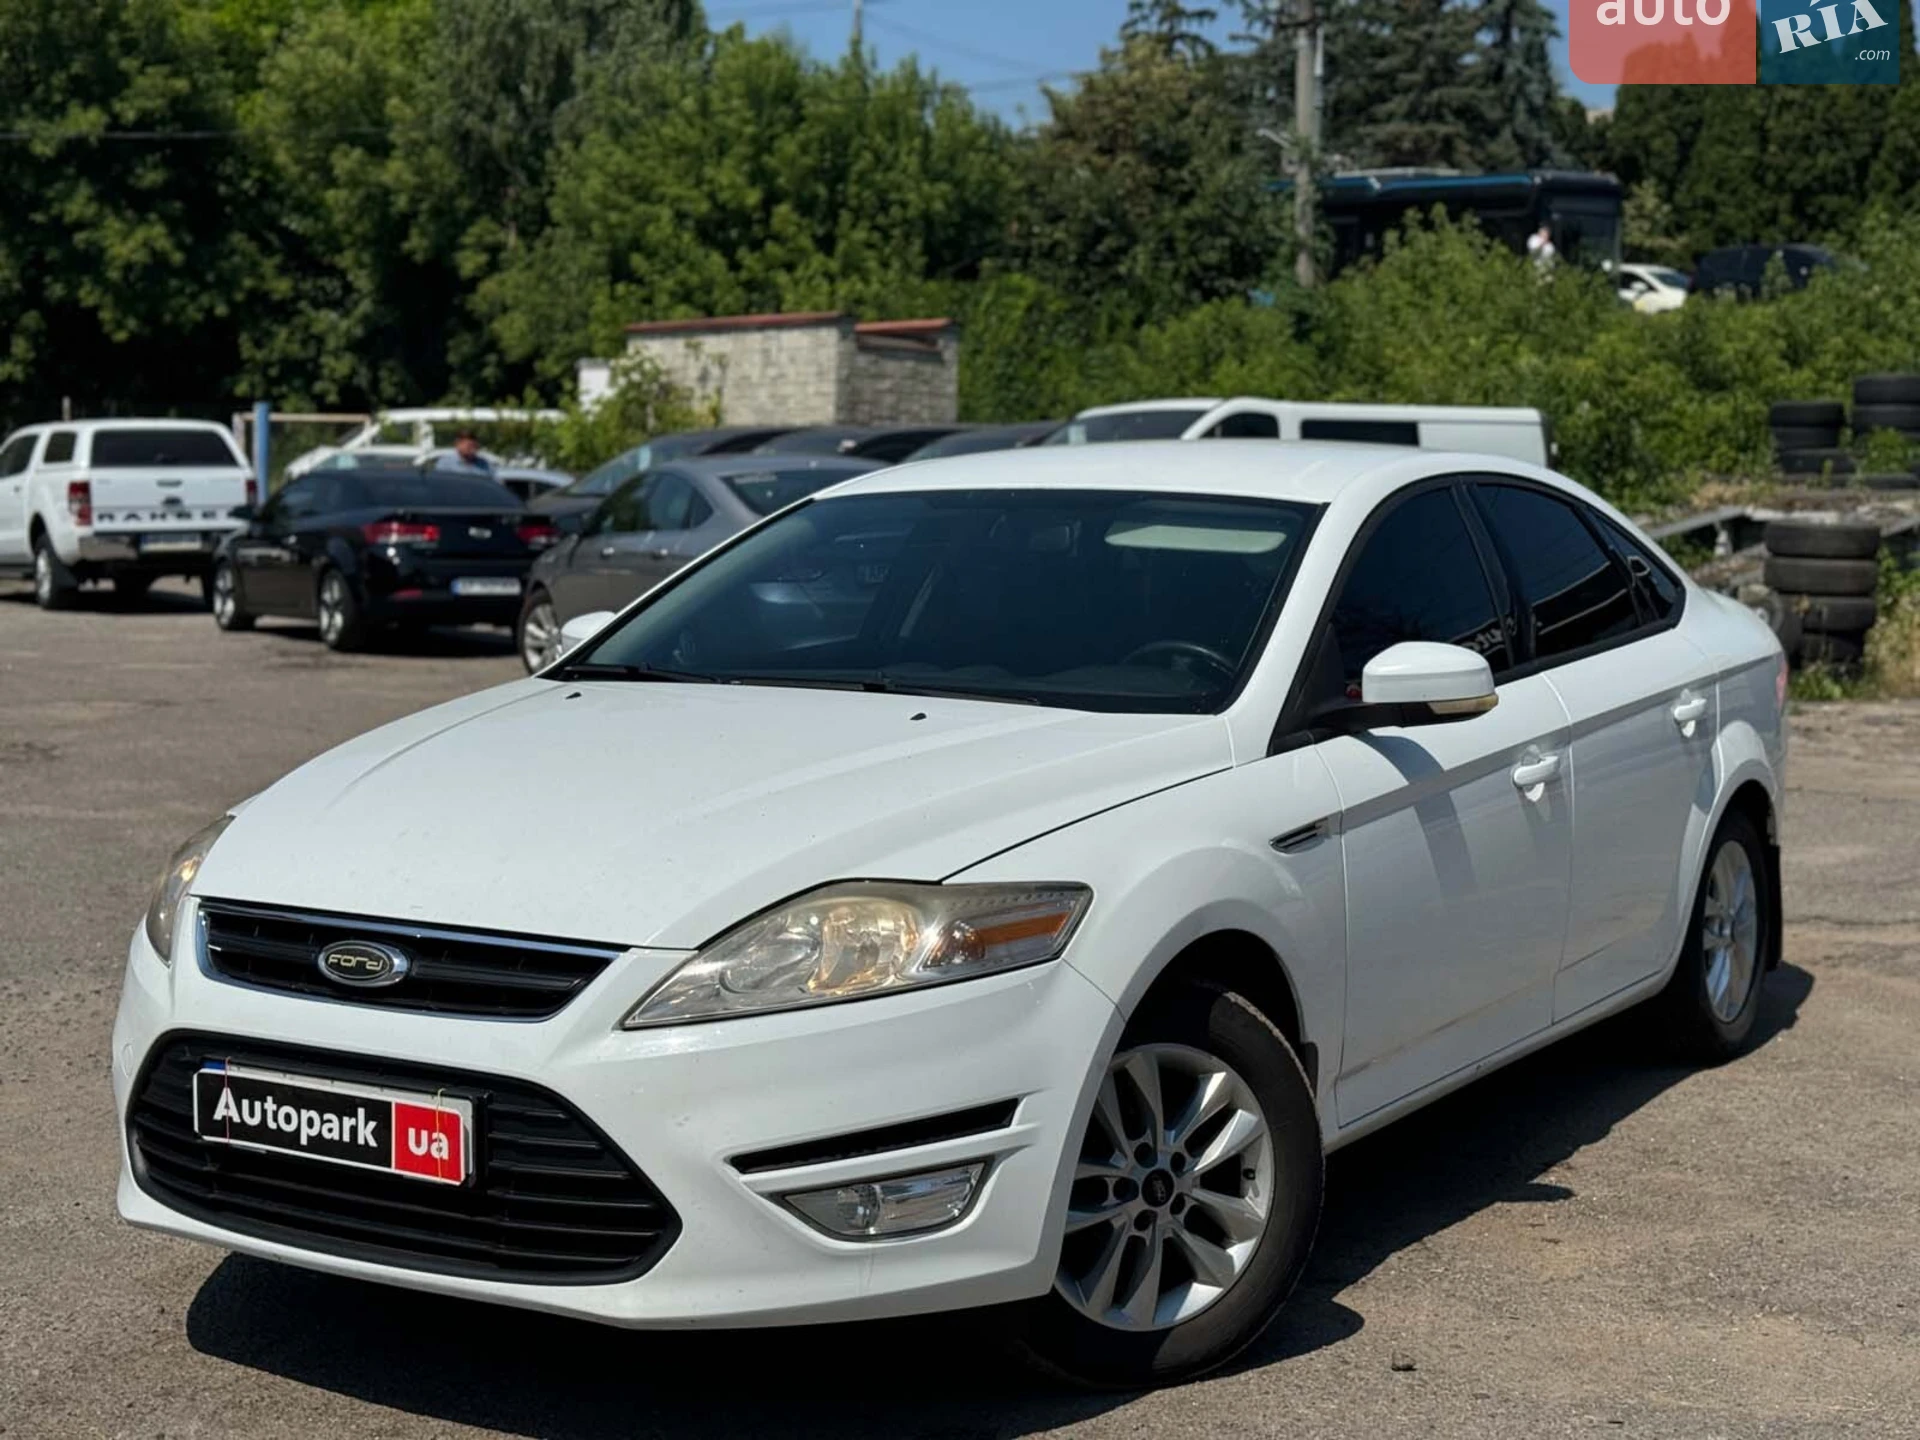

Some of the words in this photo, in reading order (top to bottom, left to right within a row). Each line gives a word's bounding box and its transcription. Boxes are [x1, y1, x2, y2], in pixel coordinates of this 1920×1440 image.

[98, 511, 238, 522] RANGE
[213, 1087, 378, 1148] Autopark
[407, 1126, 450, 1161] ua
